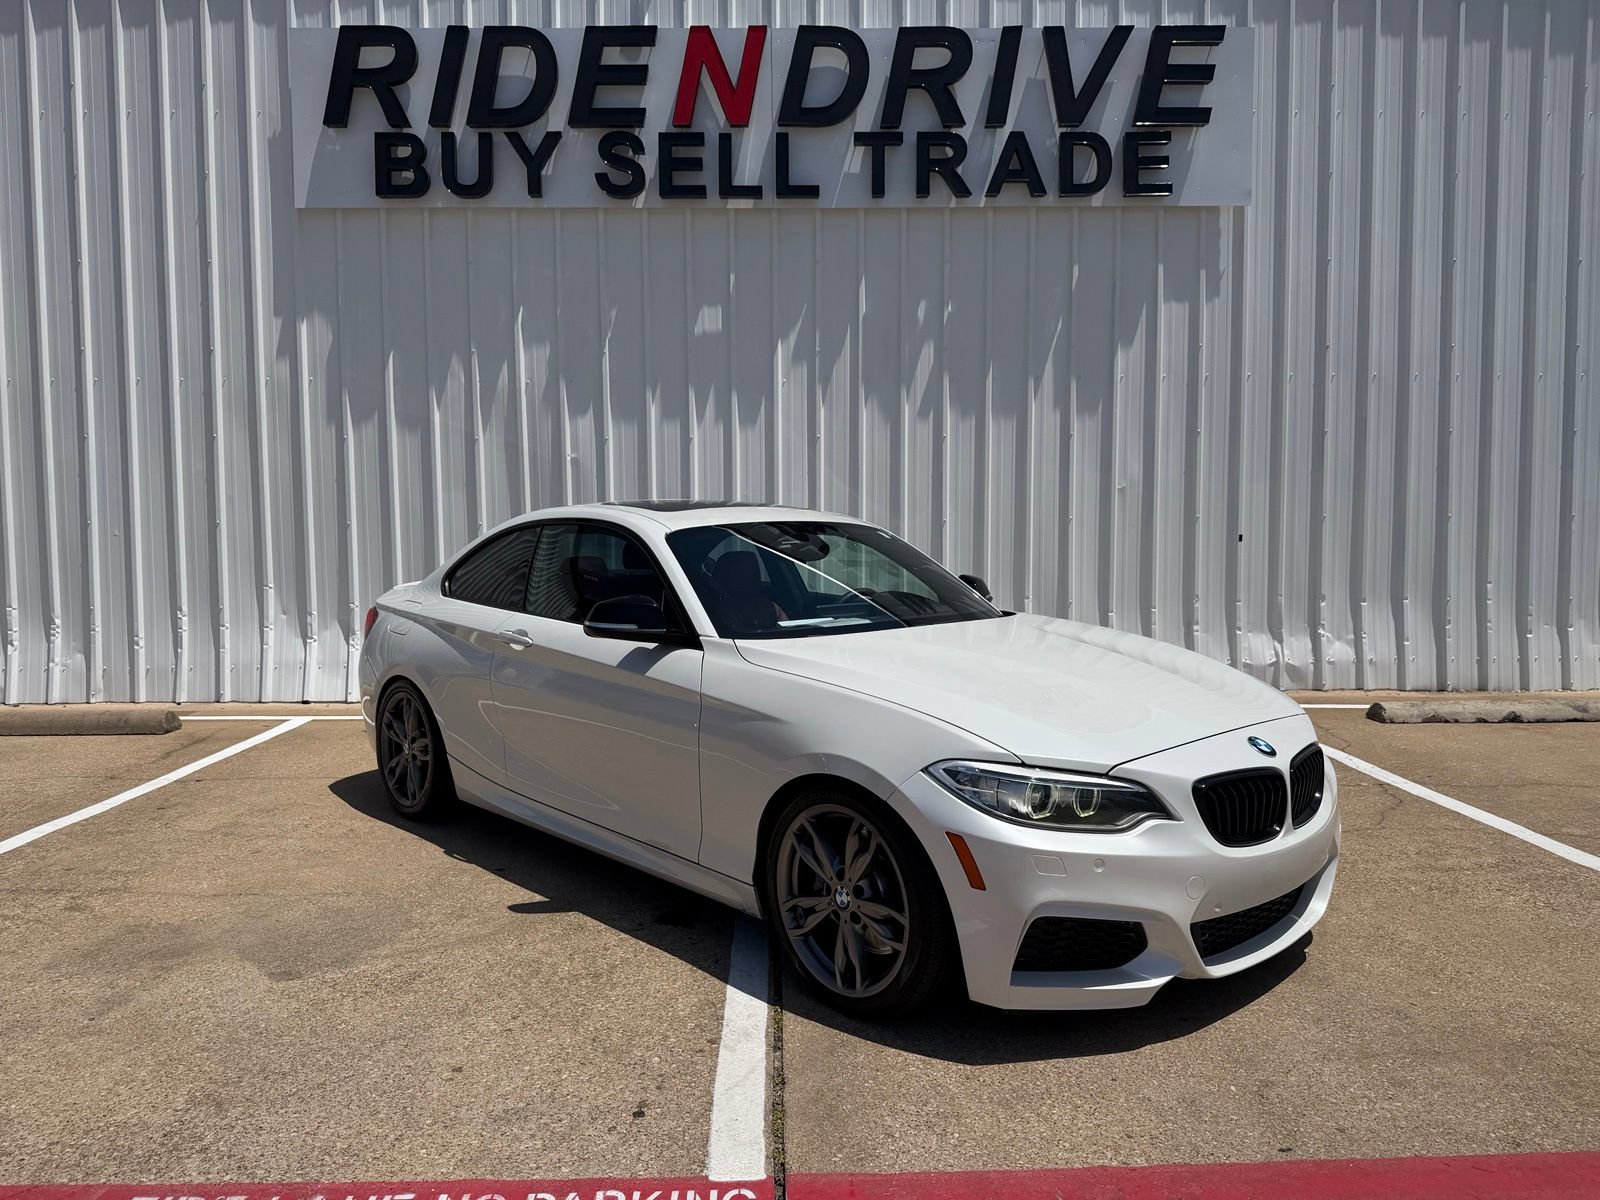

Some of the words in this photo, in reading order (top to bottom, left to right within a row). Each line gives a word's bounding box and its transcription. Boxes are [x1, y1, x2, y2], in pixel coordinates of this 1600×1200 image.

[374, 131, 562, 199] BUY
[594, 131, 820, 200] SELL
[853, 131, 1173, 198] TRADE
